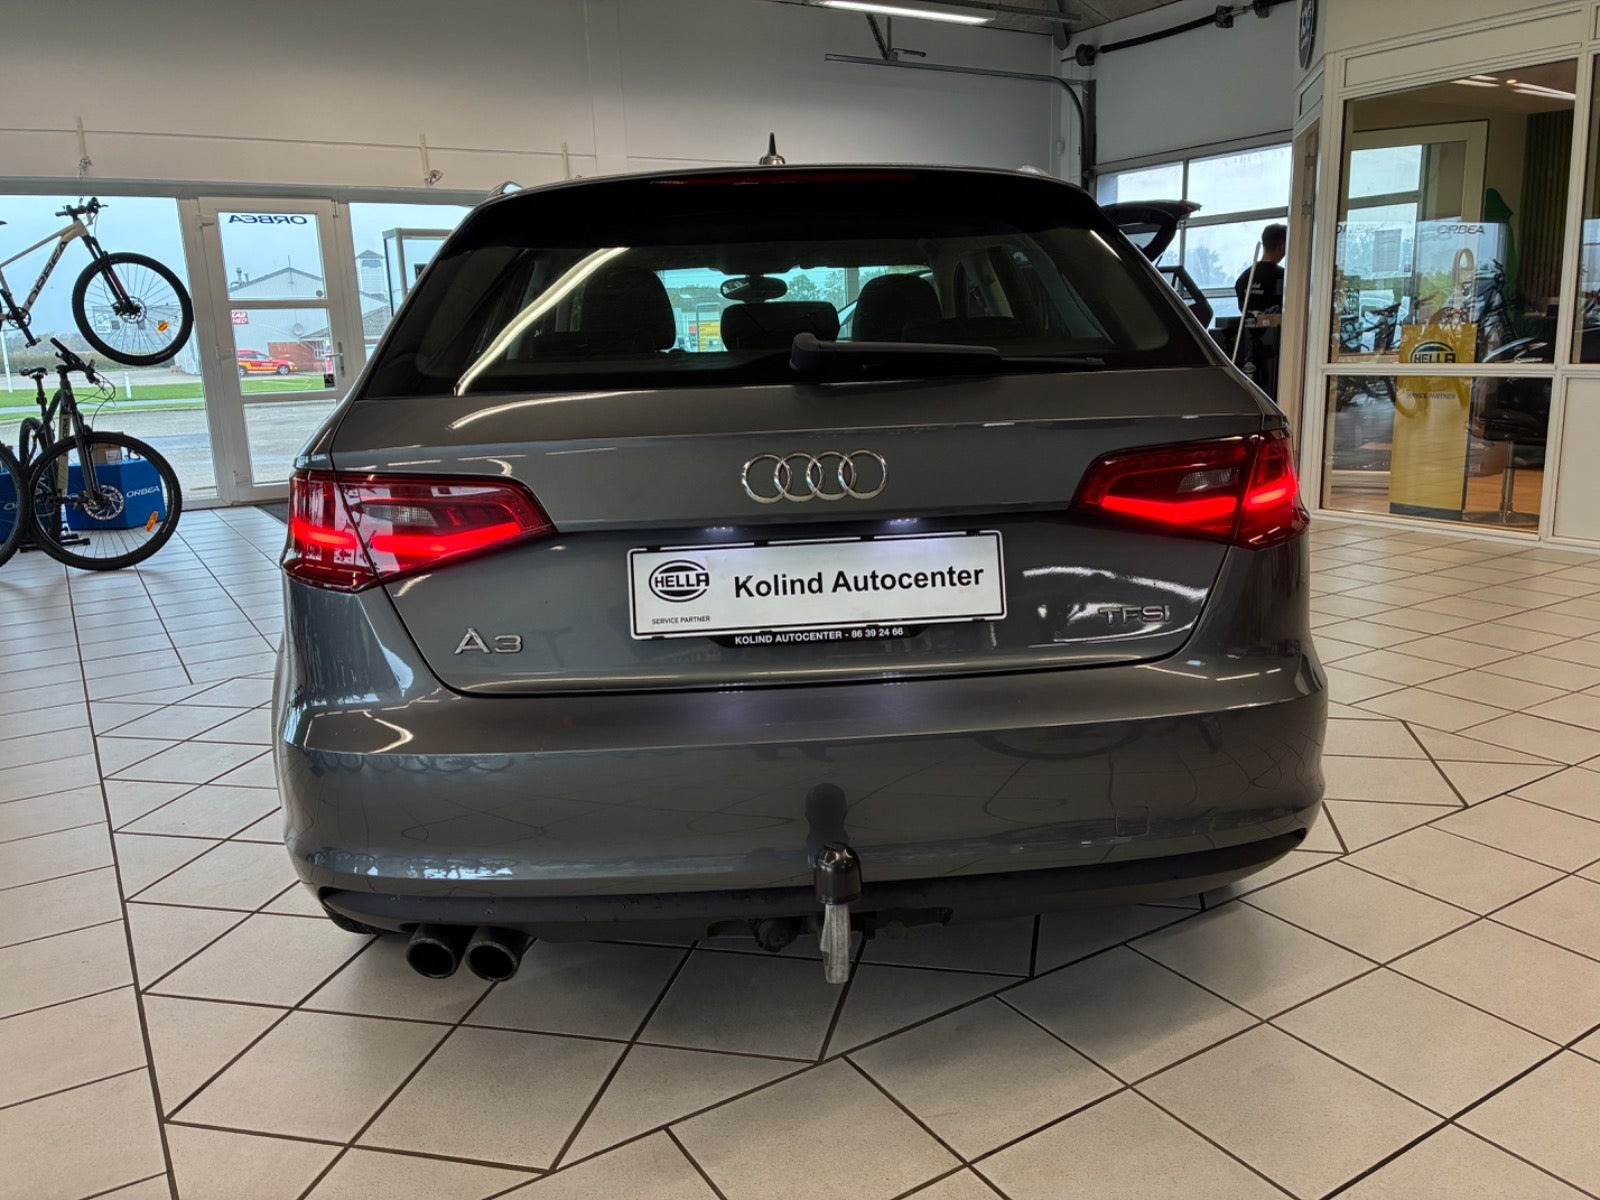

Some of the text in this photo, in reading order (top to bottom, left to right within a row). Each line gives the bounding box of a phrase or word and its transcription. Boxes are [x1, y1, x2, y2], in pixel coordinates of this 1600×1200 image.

[1437, 225, 1485, 235] ORBEA
[27, 240, 69, 306] ORBEA
[126, 486, 161, 499] ORBEA
[654, 573, 710, 589] HELLA
[734, 565, 984, 598] Kolind Autocenter
[651, 615, 711, 625] SERVICE PARTNER
[1098, 604, 1170, 625] TFSI
[454, 627, 523, 655] A3
[734, 634, 773, 645] KOLIND
[775, 630, 842, 643] AUTOCENTER
[851, 630, 863, 639] 86
[864, 628, 877, 638] 39
[878, 628, 890, 637] 24
[892, 627, 904, 636] 66
